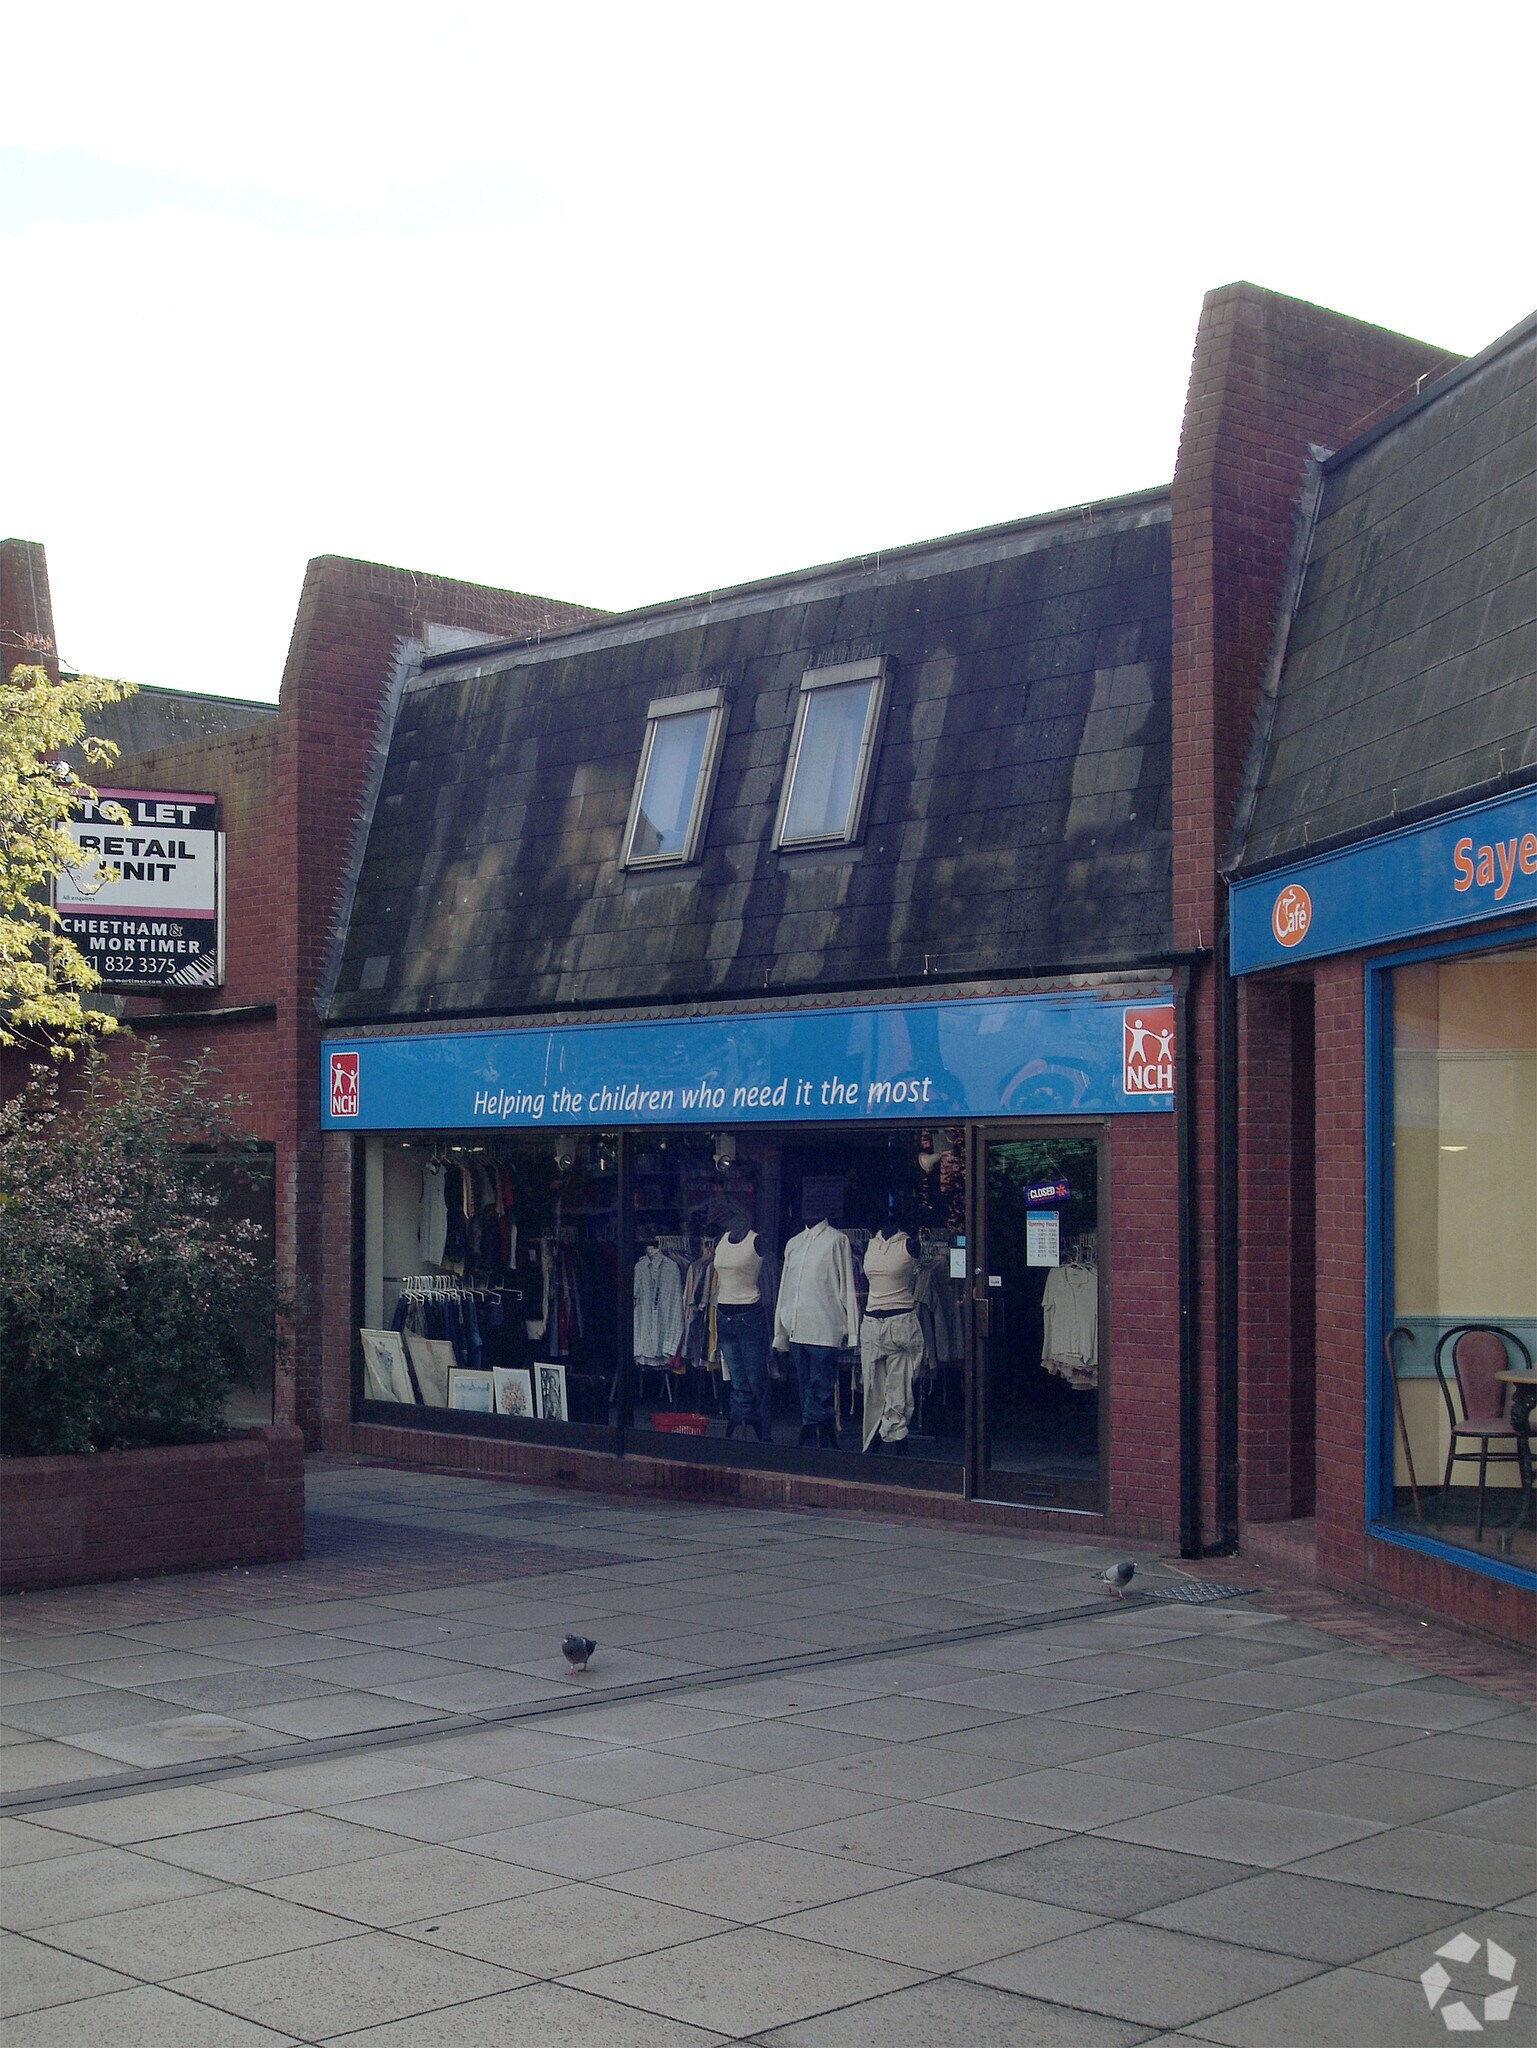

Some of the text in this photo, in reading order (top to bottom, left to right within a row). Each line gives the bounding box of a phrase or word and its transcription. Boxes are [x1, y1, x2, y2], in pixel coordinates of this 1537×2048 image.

[80, 799, 197, 825] TO LET
[79, 835, 196, 860] RETAIL
[1275, 899, 1307, 938] Café
[90, 937, 201, 954] MORTIMER
[105, 956, 135, 973] 832
[138, 957, 176, 974] 3375
[1127, 1064, 1173, 1090] NCH
[333, 1095, 357, 1114] NCH
[473, 1075, 932, 1119] Helping the children who need it the most
[1029, 1186, 1056, 1200] CLOSED
